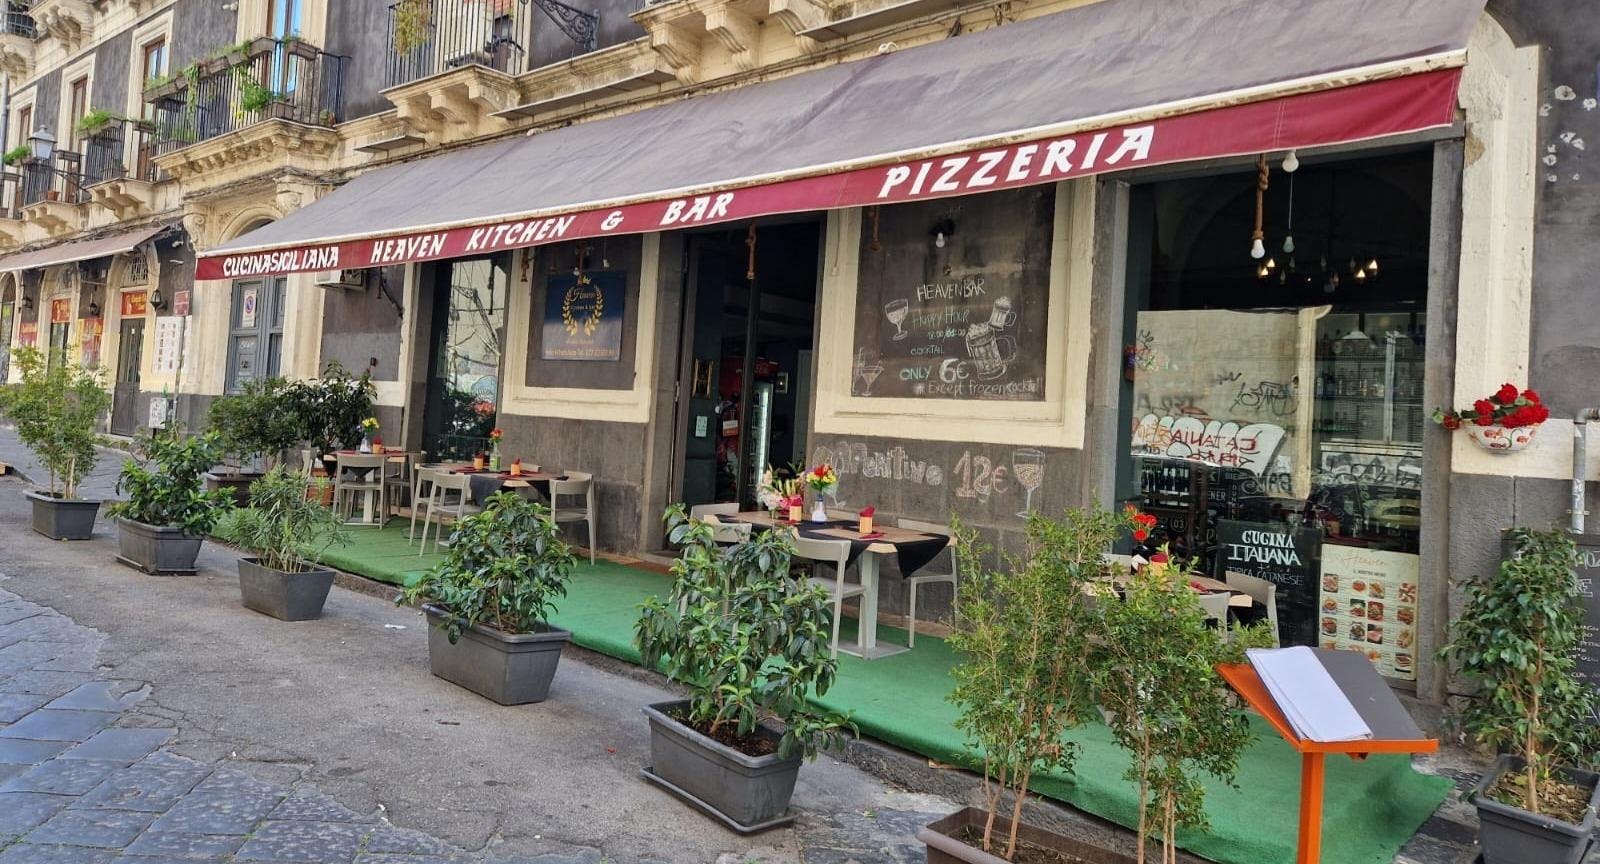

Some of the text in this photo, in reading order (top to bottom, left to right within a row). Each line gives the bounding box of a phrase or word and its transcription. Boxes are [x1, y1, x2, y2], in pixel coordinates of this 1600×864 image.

[371, 233, 448, 263] HEAVEN
[466, 215, 577, 252] KITCHEN
[601, 210, 625, 231] &
[661, 192, 735, 226] BAR
[877, 126, 1155, 198] PIZZERIA
[900, 366, 932, 380] ONLY
[1242, 530, 1295, 548] CUCINA
[1227, 543, 1302, 566] ITALIANA
